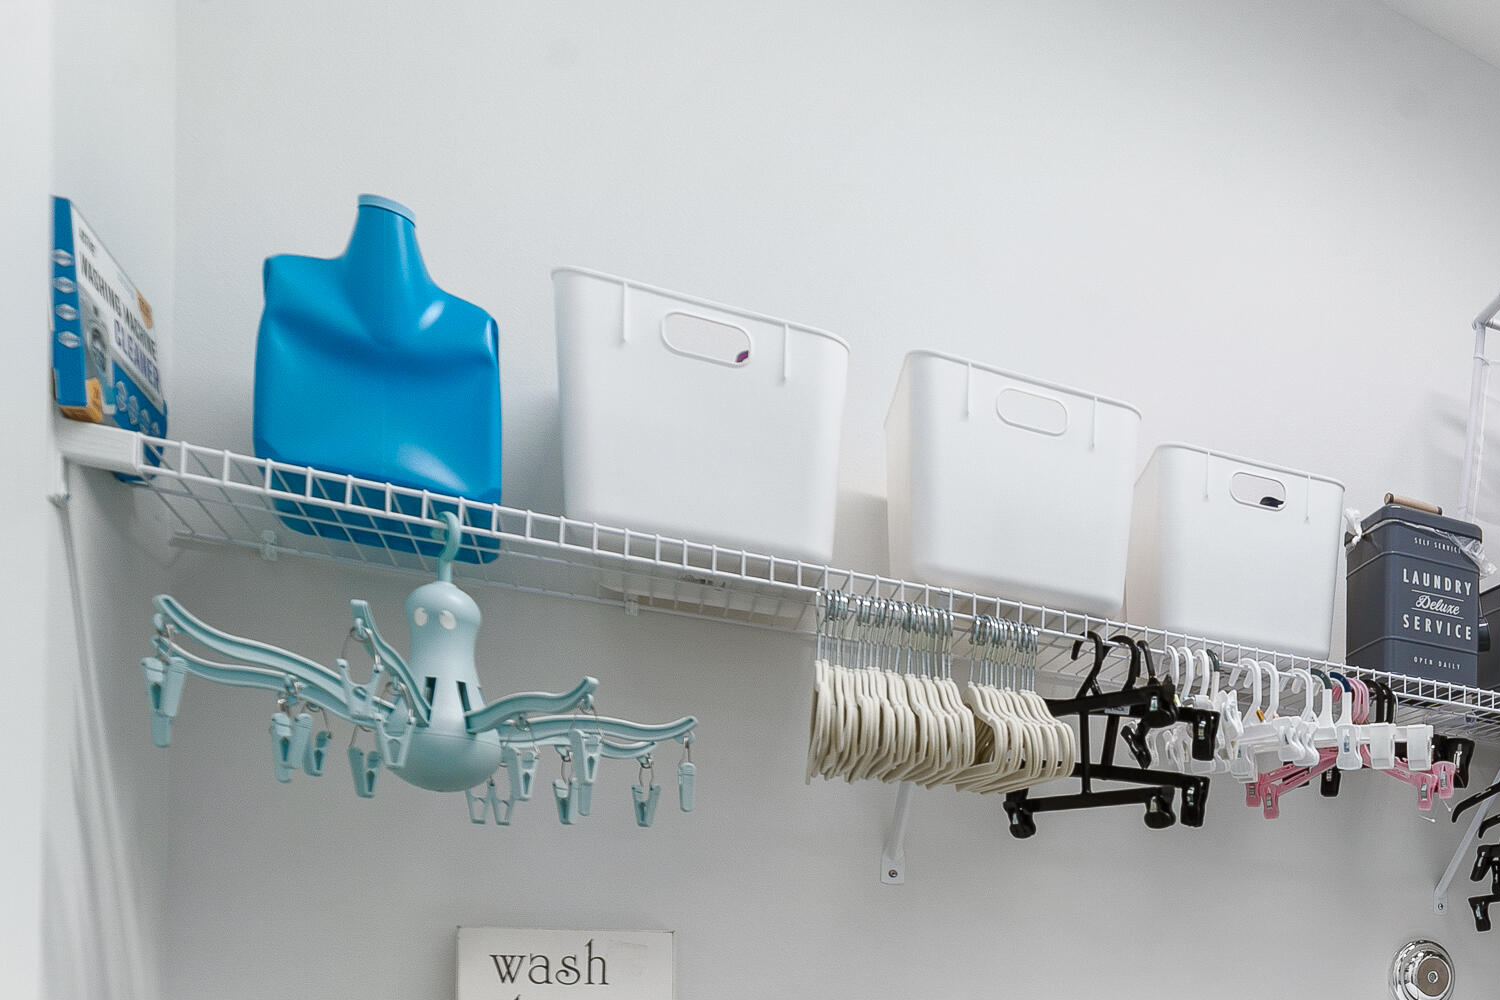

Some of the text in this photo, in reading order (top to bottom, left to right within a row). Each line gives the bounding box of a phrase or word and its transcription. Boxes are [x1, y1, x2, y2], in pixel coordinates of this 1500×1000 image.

[79, 253, 122, 318] WASHING
[113, 318, 160, 394] CLEANER
[1403, 568, 1471, 596] LAUNDRY
[1415, 594, 1460, 615] Deluxe
[1402, 614, 1472, 641] SERVICE
[1413, 656, 1461, 670] OPEN DAILY
[489, 938, 610, 985] wash
